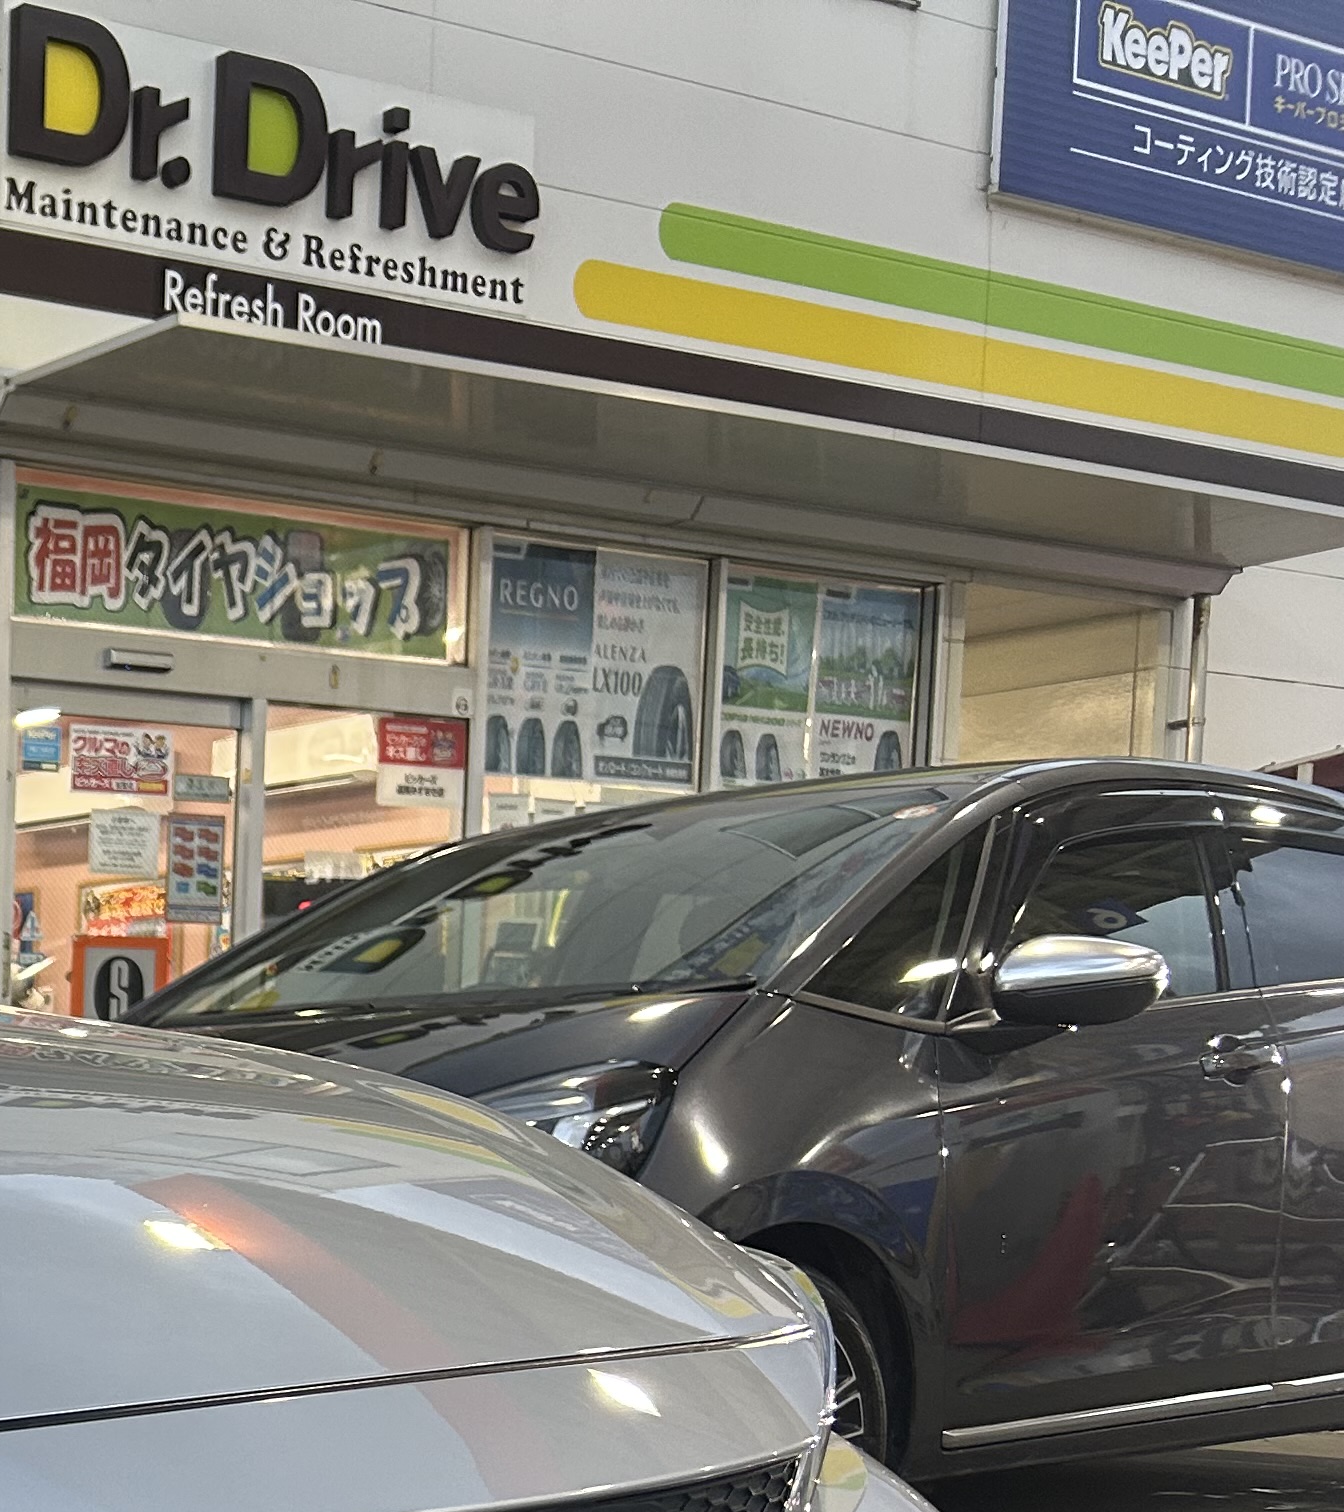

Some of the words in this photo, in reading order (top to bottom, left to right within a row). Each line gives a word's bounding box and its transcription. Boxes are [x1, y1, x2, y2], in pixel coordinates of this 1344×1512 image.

[1100, 5, 1231, 97] KeePer
[1273, 53, 1323, 98] PRO
[7, 4, 191, 189] Dr.
[212, 50, 540, 254] Drive
[1133, 124, 1344, 209] コーティング技術認定
[5, 177, 247, 254] Maintenance
[263, 228, 289, 261] &
[303, 235, 524, 304] Refreshment
[164, 269, 284, 328] Refresh
[297, 306, 382, 345] Room
[29, 505, 421, 641] 福岡タイヤショップ
[499, 577, 579, 612] REGNO
[592, 666, 643, 697] LX100
[594, 643, 647, 664] ALENZA
[819, 719, 875, 742] NEWNO
